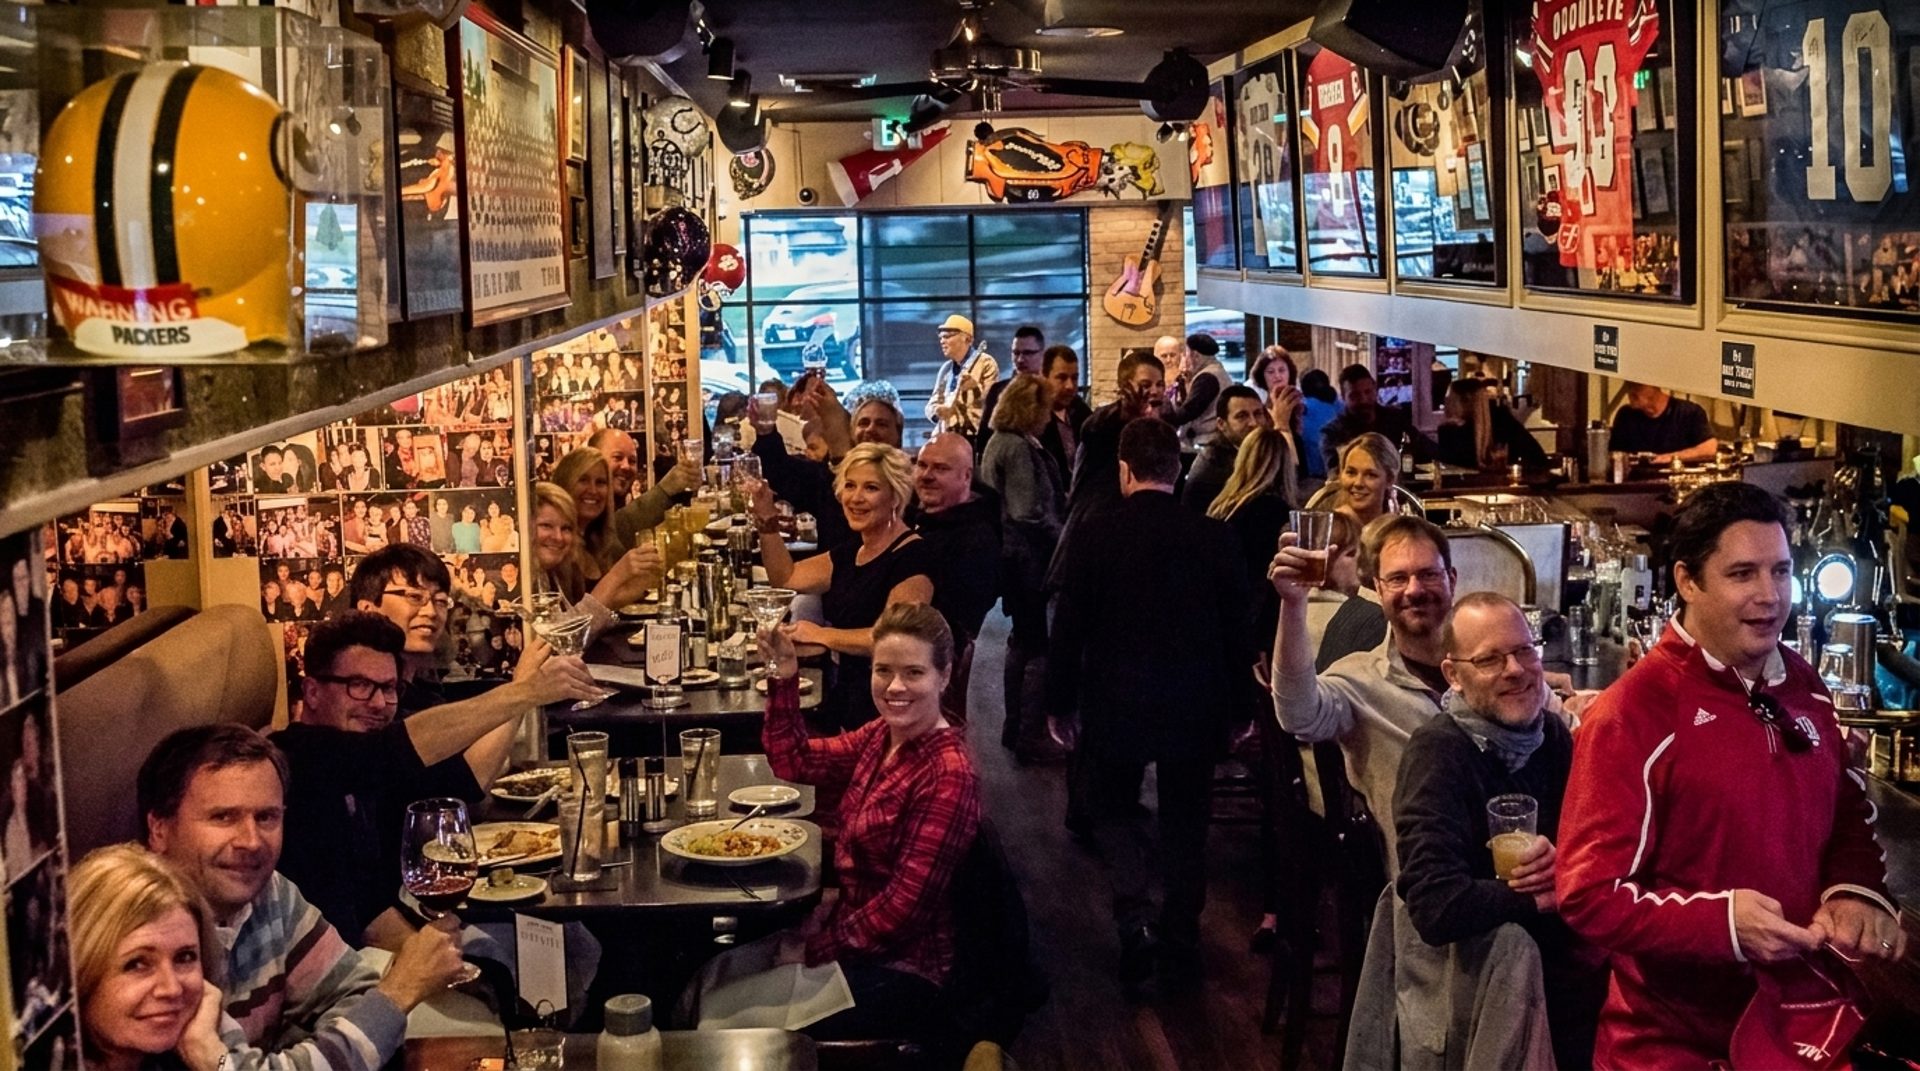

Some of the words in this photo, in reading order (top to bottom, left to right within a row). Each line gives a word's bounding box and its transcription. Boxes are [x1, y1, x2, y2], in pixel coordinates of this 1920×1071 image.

[1803, 10, 1892, 203] 10
[61, 288, 193, 323] WARNING
[112, 325, 191, 346] PACKERS
